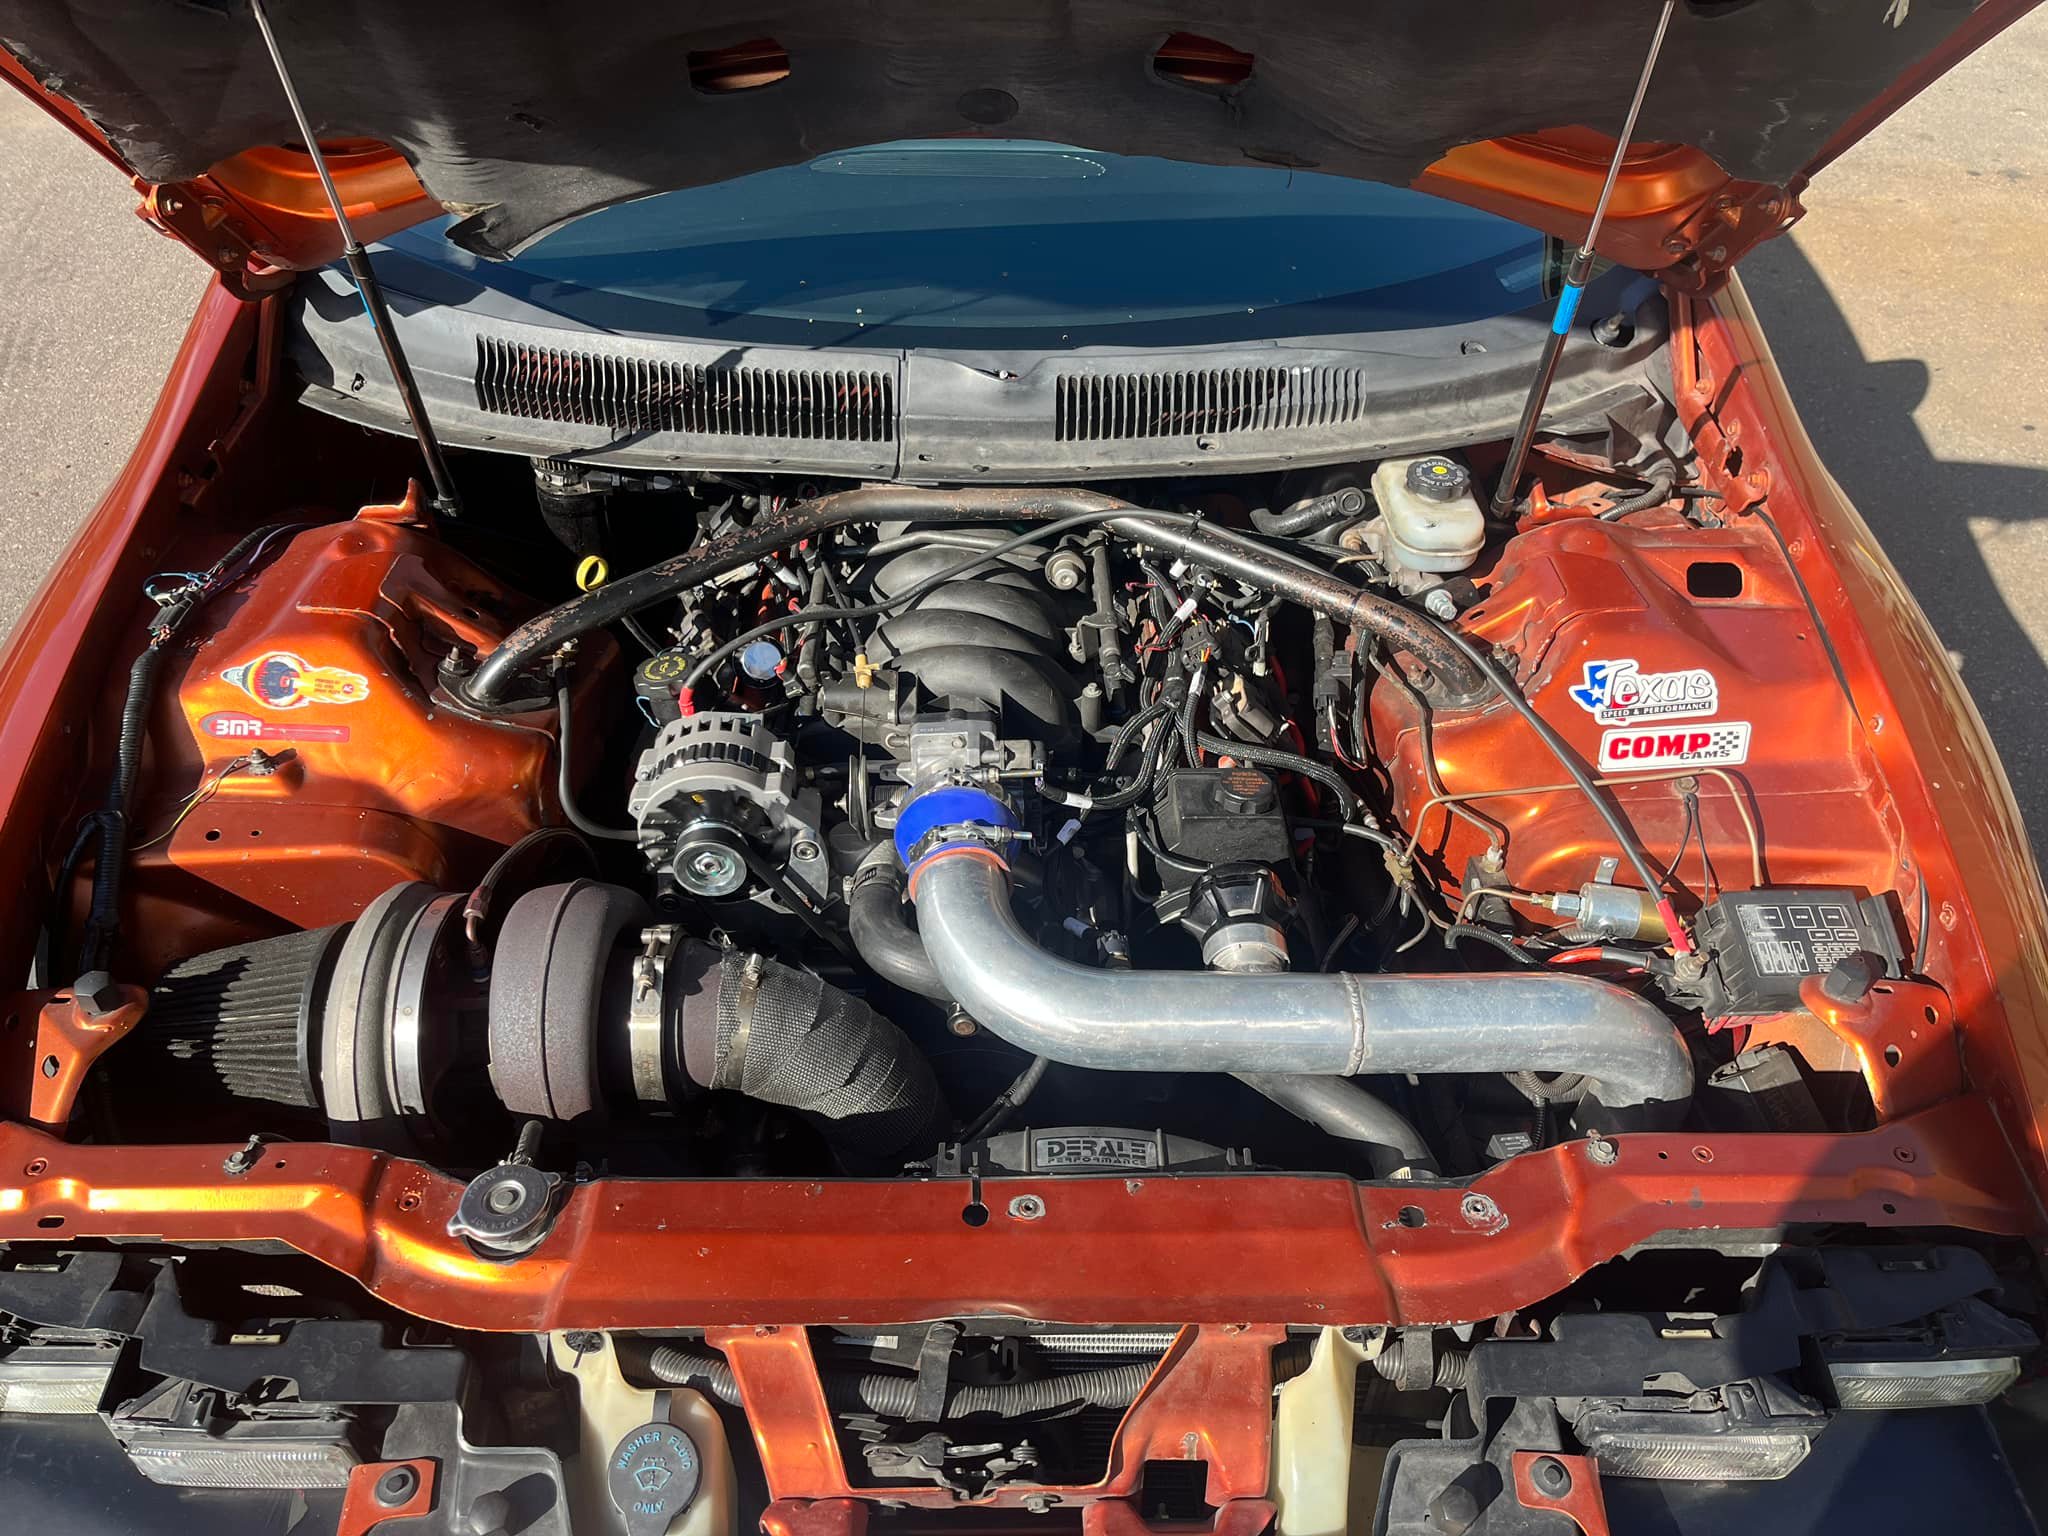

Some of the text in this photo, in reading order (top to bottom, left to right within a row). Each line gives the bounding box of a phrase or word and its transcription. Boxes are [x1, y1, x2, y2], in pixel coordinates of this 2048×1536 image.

[1595, 663, 1713, 707] Texas
[1603, 701, 1711, 719] SPEED & PERFORMANCE
[1608, 732, 1711, 760] COMP
[1679, 749, 1731, 760] CAMS
[1047, 1139, 1147, 1160] DERALE
[1047, 1155, 1147, 1166] PERFORMANCE
[616, 1431, 693, 1472] WASHER FLUID
[633, 1498, 665, 1514] ONLY
